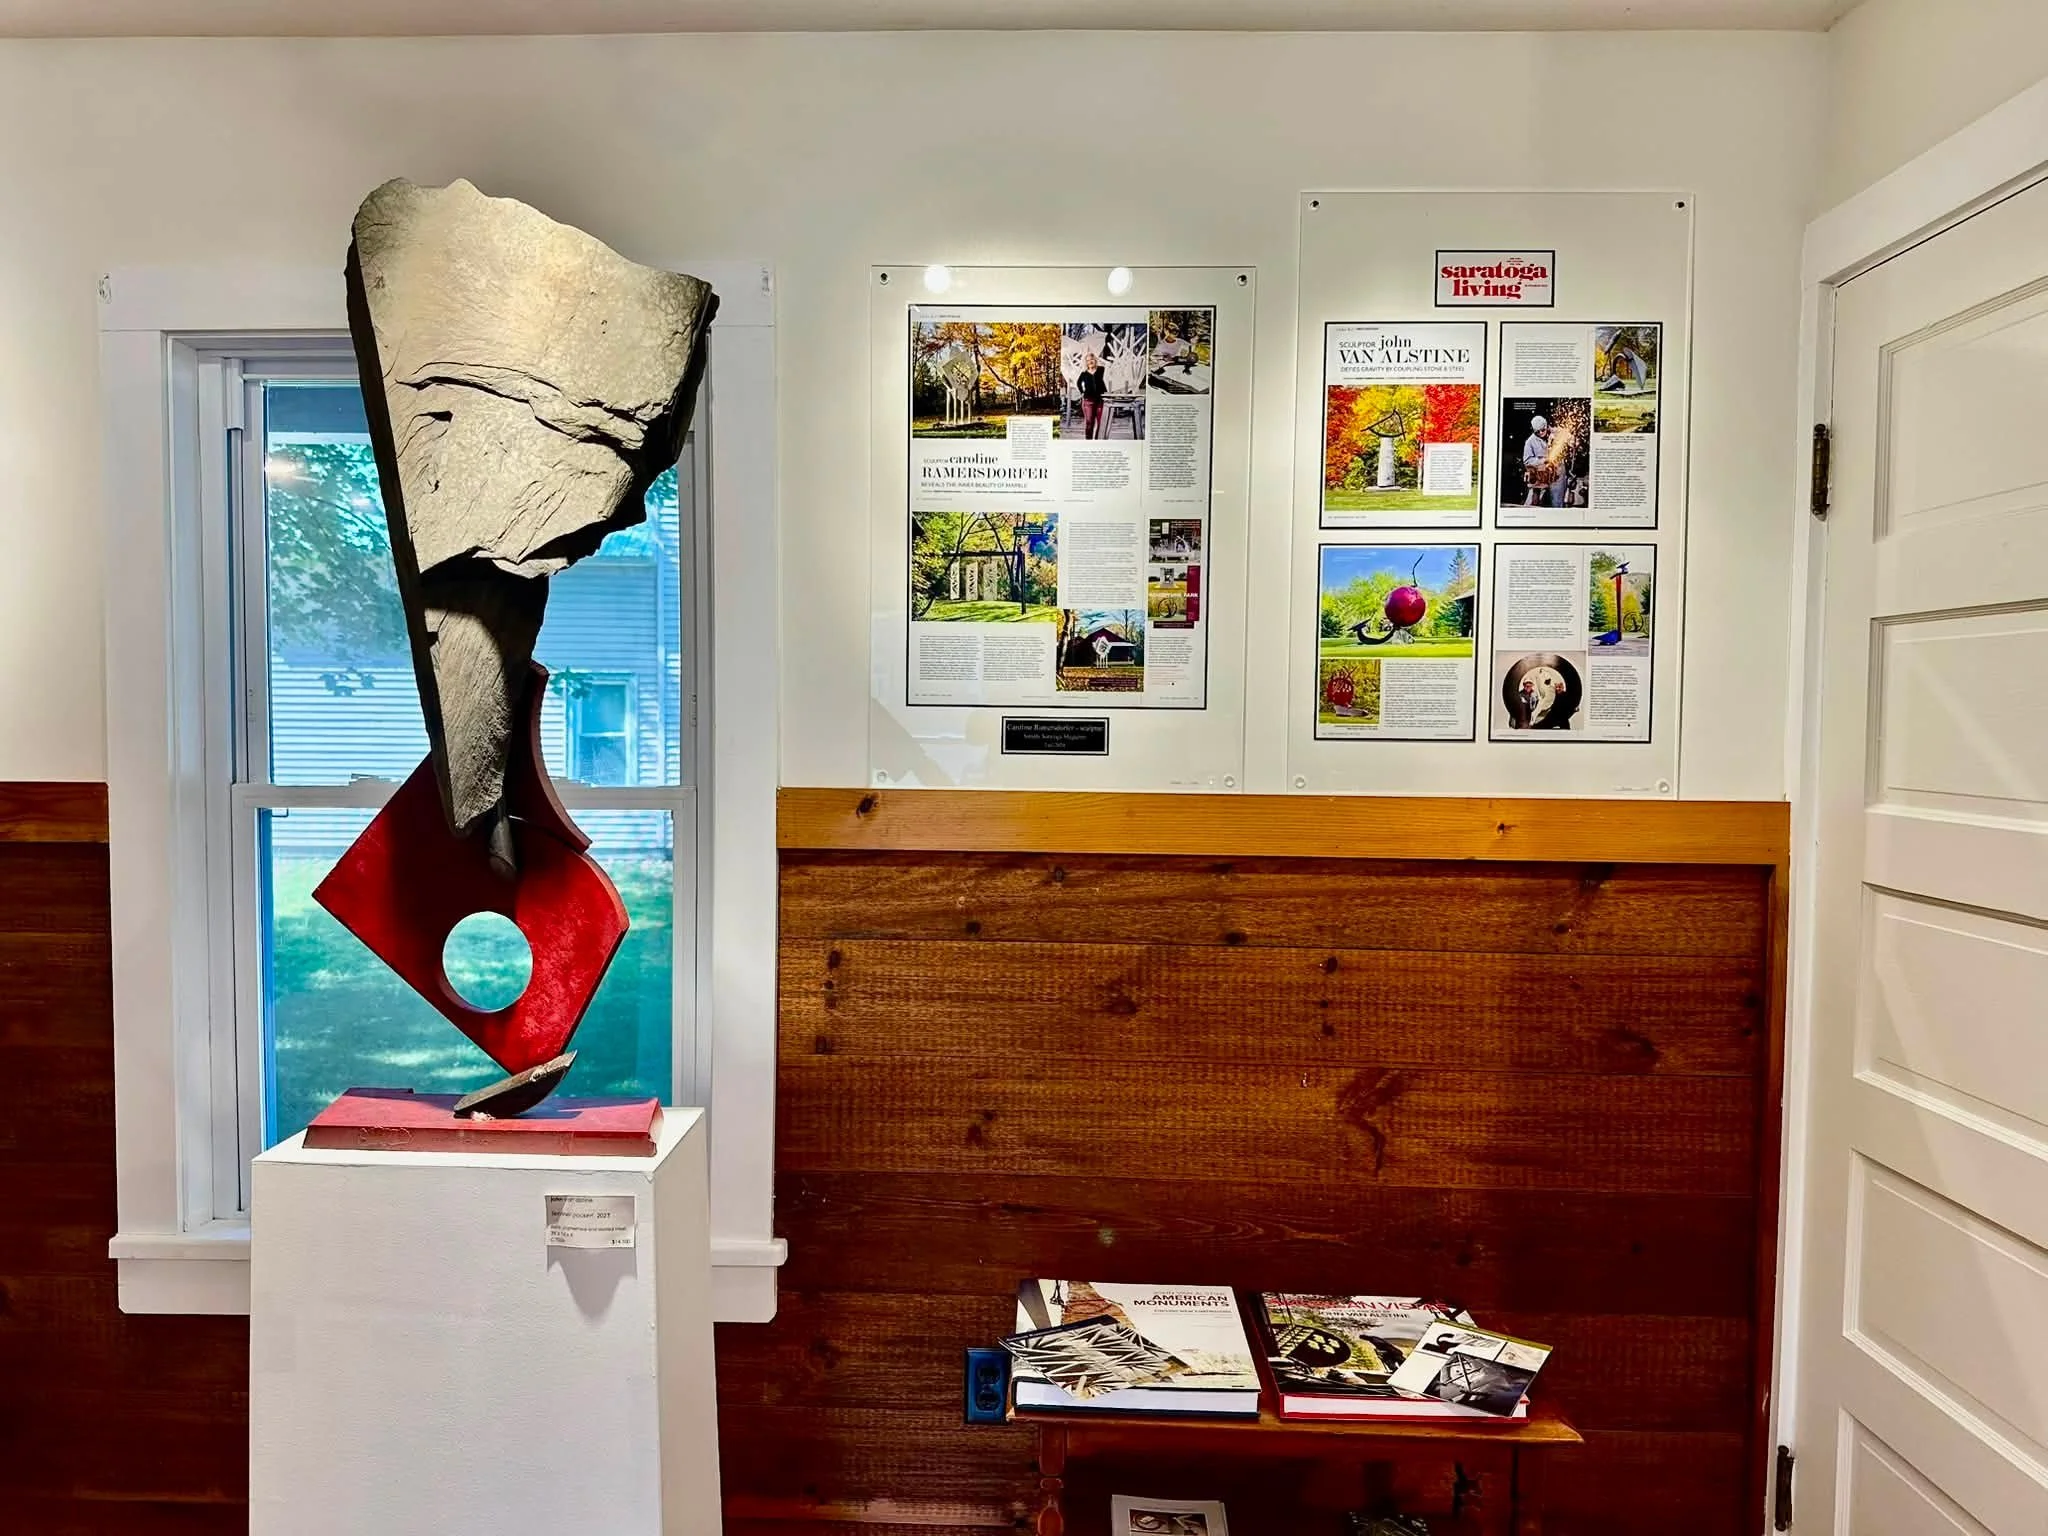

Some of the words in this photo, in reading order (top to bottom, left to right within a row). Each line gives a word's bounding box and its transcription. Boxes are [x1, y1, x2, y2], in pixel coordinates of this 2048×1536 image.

[1441, 261, 1548, 281] saratoga
[1453, 280, 1521, 300] living
[1378, 335, 1412, 351] john
[1340, 349, 1375, 364] VAN
[1381, 349, 1470, 363] ALSTINE
[949, 453, 998, 464] caroline
[922, 466, 1048, 479] RAMERSDORFER
